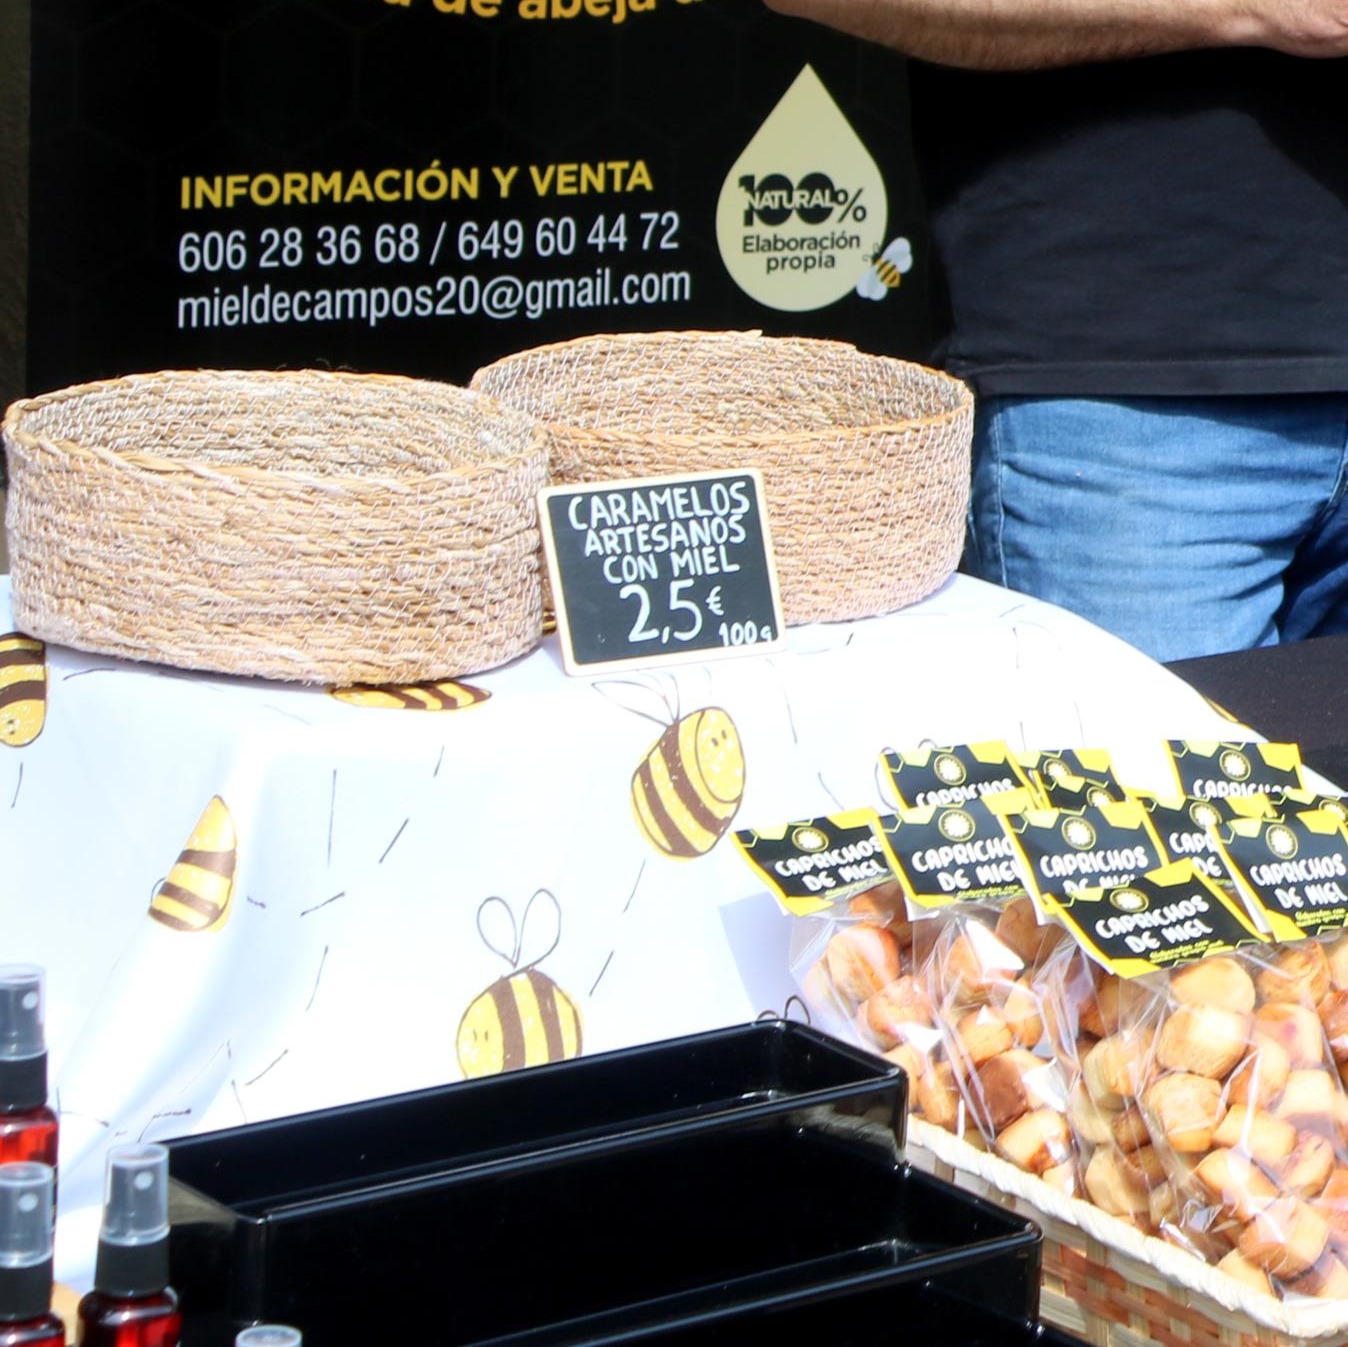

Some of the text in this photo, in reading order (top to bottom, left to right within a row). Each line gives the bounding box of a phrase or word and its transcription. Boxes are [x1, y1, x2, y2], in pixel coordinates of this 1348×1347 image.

[180, 160, 654, 209] INFORMACIÓN Y VENTA
[177, 211, 680, 273] 606 28 36 68 / 649 60 44 72
[742, 231, 861, 253] Elaboración
[766, 253, 836, 274] propia
[177, 268, 692, 329] mieldecampos20@gmail.com
[568, 481, 750, 530] CARAMELOS
[584, 513, 747, 557] ARTESANOS
[602, 545, 740, 584] CON MIEL
[774, 835, 883, 877] CAPRICHOS
[1039, 845, 1149, 878] CAPRICHOS
[1249, 853, 1347, 887] CAPRICHOS
[801, 871, 836, 892] DE
[838, 859, 888, 883] MIEL
[937, 868, 971, 892] DE
[1274, 882, 1348, 909] DE MIEL
[1095, 895, 1210, 939] CAPRICHOS
[1124, 918, 1213, 954] DE MIEL
